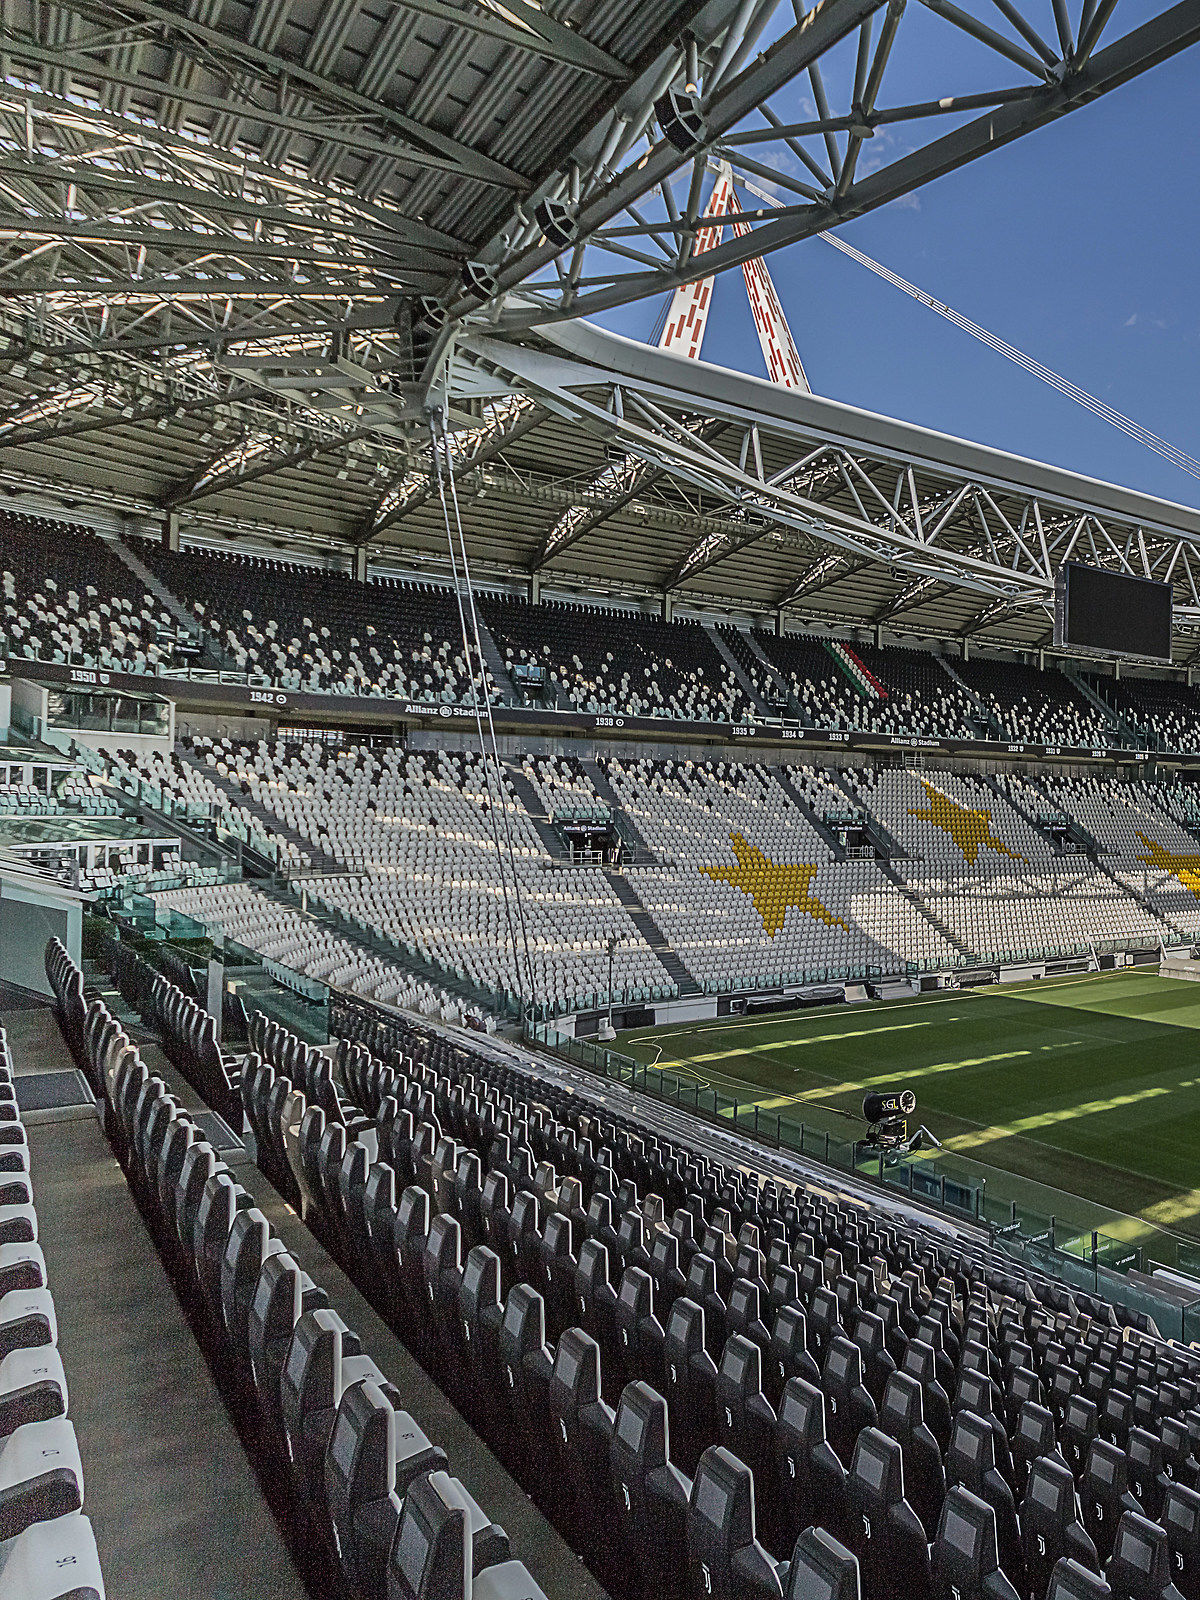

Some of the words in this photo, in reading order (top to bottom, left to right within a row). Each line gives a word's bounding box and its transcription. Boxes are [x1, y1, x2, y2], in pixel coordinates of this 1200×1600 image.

[70, 670, 97, 684] 1950
[250, 691, 274, 704] 1942
[404, 704, 439, 715] Allianz
[595, 717, 614, 727] 1938
[890, 737, 910, 745] Allianz
[918, 739, 940, 747] Stadium
[881, 1098, 899, 1109] SGL
[56, 1555, 77, 1568] 16
